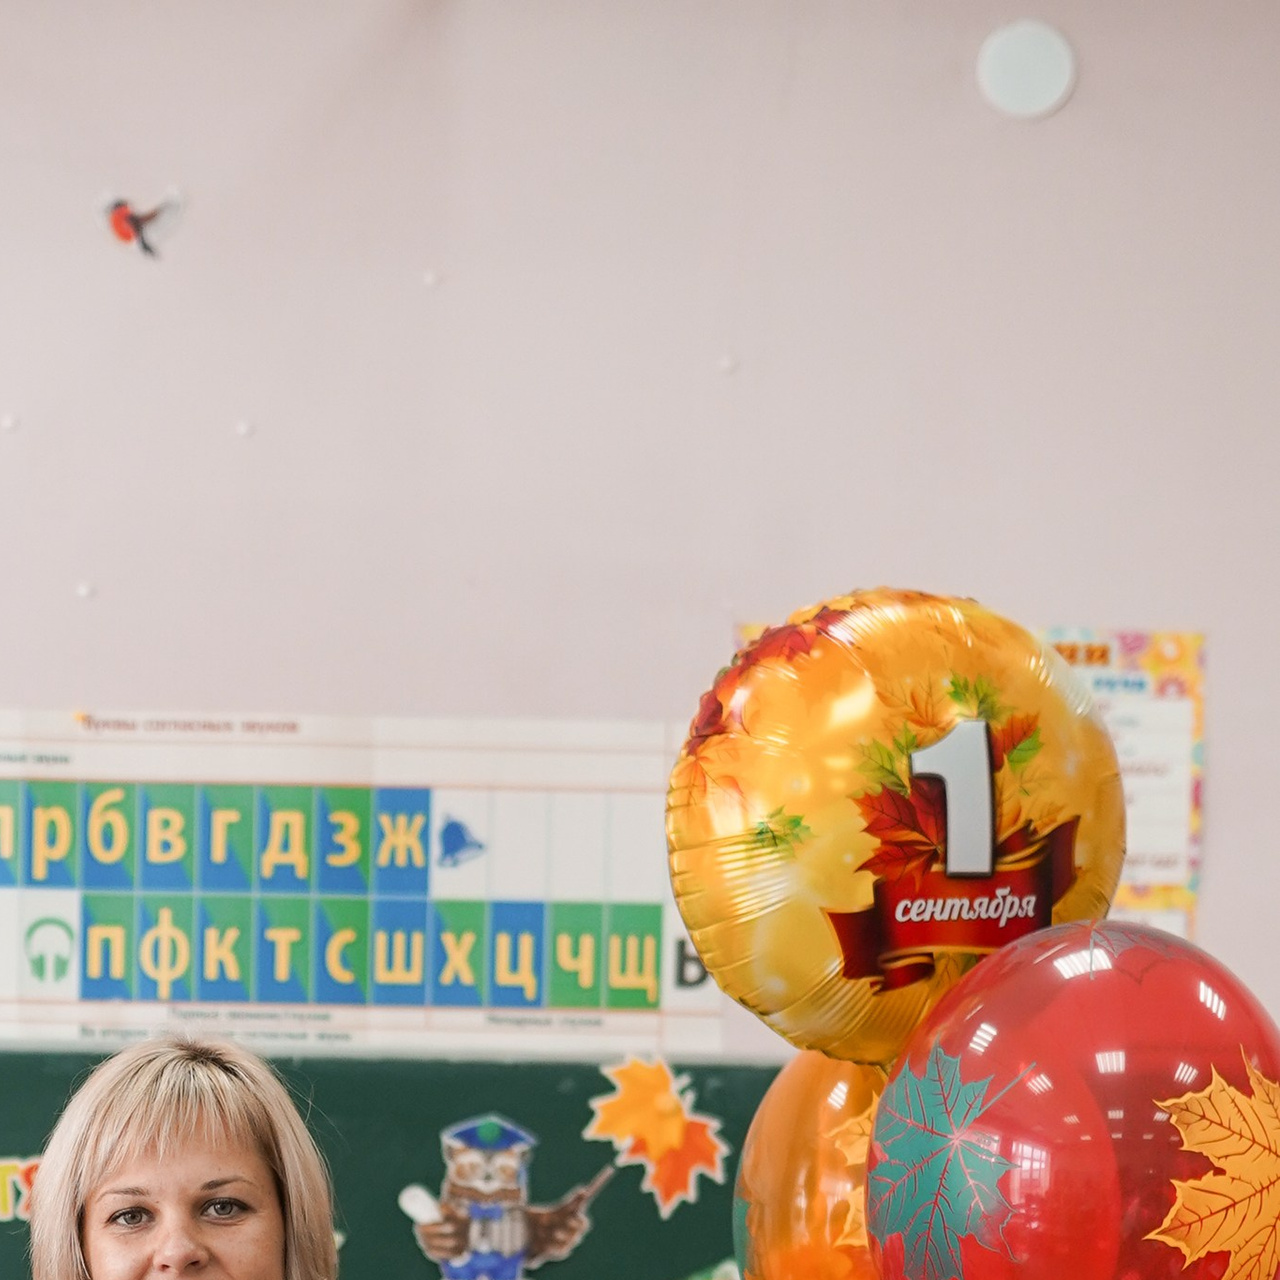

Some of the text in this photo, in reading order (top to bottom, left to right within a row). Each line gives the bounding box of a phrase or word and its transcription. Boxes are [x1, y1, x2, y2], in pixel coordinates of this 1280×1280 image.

[32, 807, 73, 881] р
[87, 788, 130, 864] б
[146, 809, 187, 864] в
[211, 810, 241, 864] г
[261, 811, 308, 879] д
[326, 811, 362, 867] з
[376, 813, 427, 868] ж
[910, 719, 994, 877] 1
[895, 887, 1038, 928] сентября
[86, 925, 126, 981] п
[139, 907, 190, 1000] ф
[204, 927, 241, 982] к
[264, 928, 301, 983] т
[325, 929, 357, 984] с
[374, 930, 424, 985] ш
[439, 931, 476, 986] х
[495, 932, 537, 1002] ц
[555, 933, 595, 989] ч
[607, 934, 657, 1003] щ
